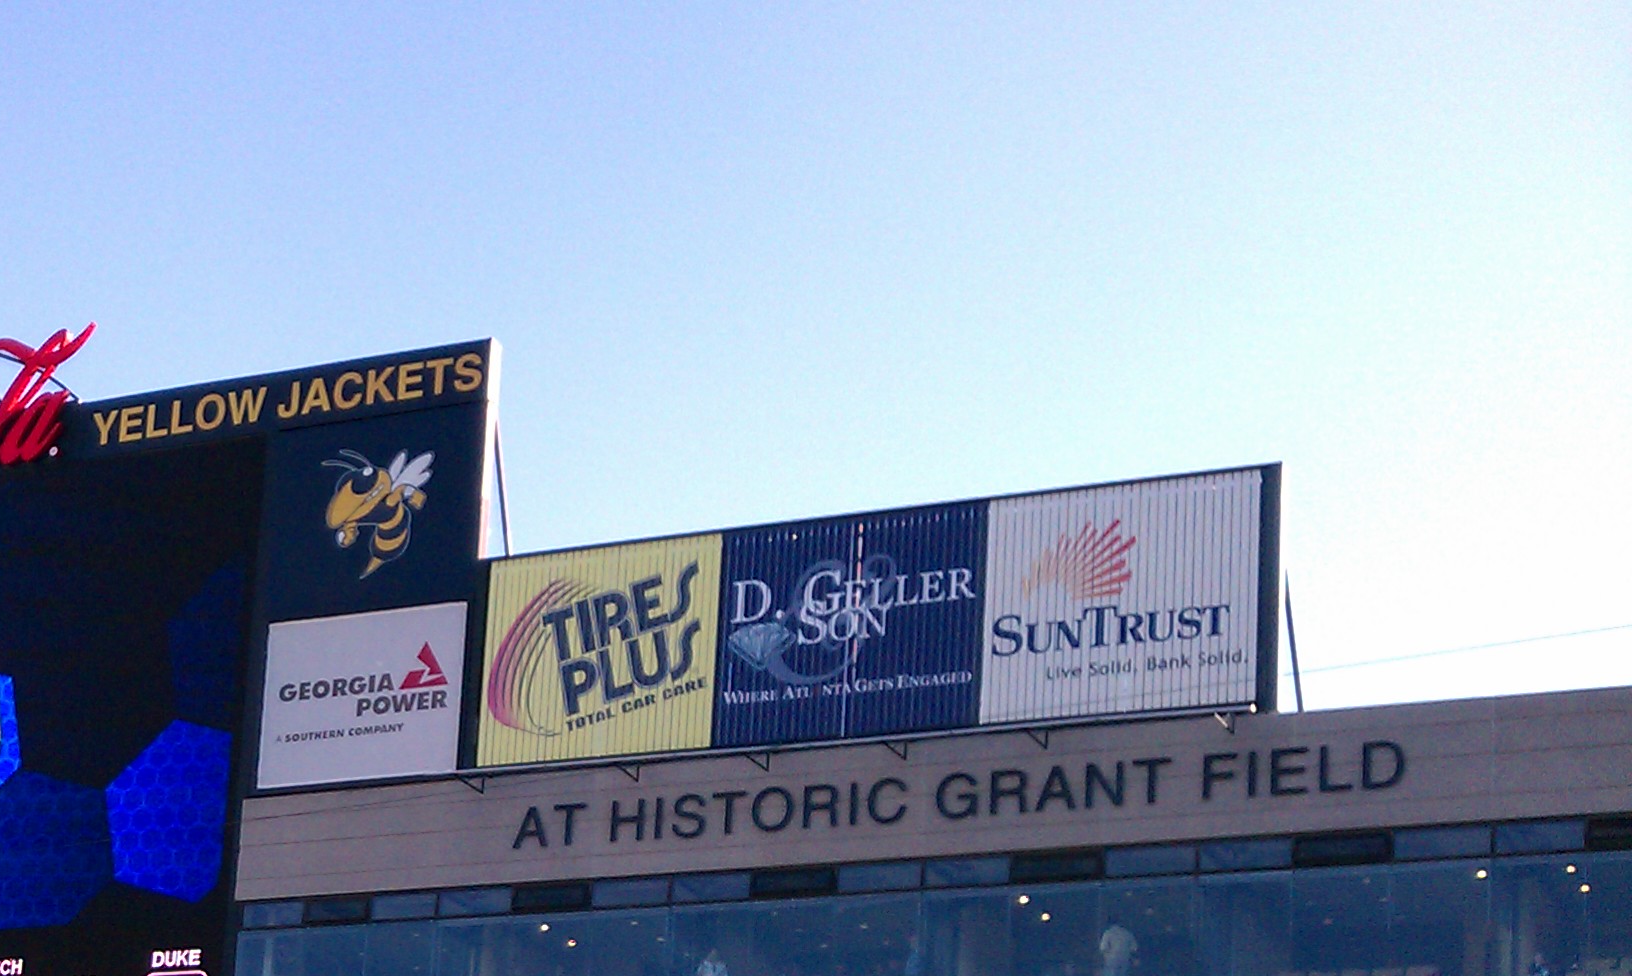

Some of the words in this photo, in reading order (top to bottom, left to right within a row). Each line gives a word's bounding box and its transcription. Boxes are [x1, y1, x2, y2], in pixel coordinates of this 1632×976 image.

[93, 386, 267, 446] YELLOW
[277, 353, 483, 418] JACKETS
[541, 559, 700, 662] TIRES
[731, 578, 786, 625] D.
[803, 567, 976, 616] GELLER
[798, 600, 891, 645] SON
[559, 618, 702, 716] PLUS
[1046, 664, 1082, 681] Live
[1089, 658, 1138, 677] Solid.
[1147, 652, 1192, 671] Bank
[1198, 648, 1249, 667] Solid.
[279, 673, 395, 703] GEORGIA
[356, 690, 448, 717] POWER
[566, 707, 616, 733] TOTAL
[620, 694, 657, 714] CAR
[662, 676, 708, 701] CARE
[722, 690, 778, 706] WHERE
[782, 684, 851, 701] ATLNTA
[854, 677, 895, 693] GETS
[896, 670, 973, 690] ENGAGED
[275, 734, 283, 744] A
[285, 729, 345, 743] SOUTHERN
[348, 722, 405, 737] COMPANY
[513, 802, 589, 849] AT
[609, 776, 908, 843] HISTORIC
[936, 756, 1173, 820] GRANT
[1202, 738, 1408, 799] FIELD
[151, 949, 202, 968] DUKE
